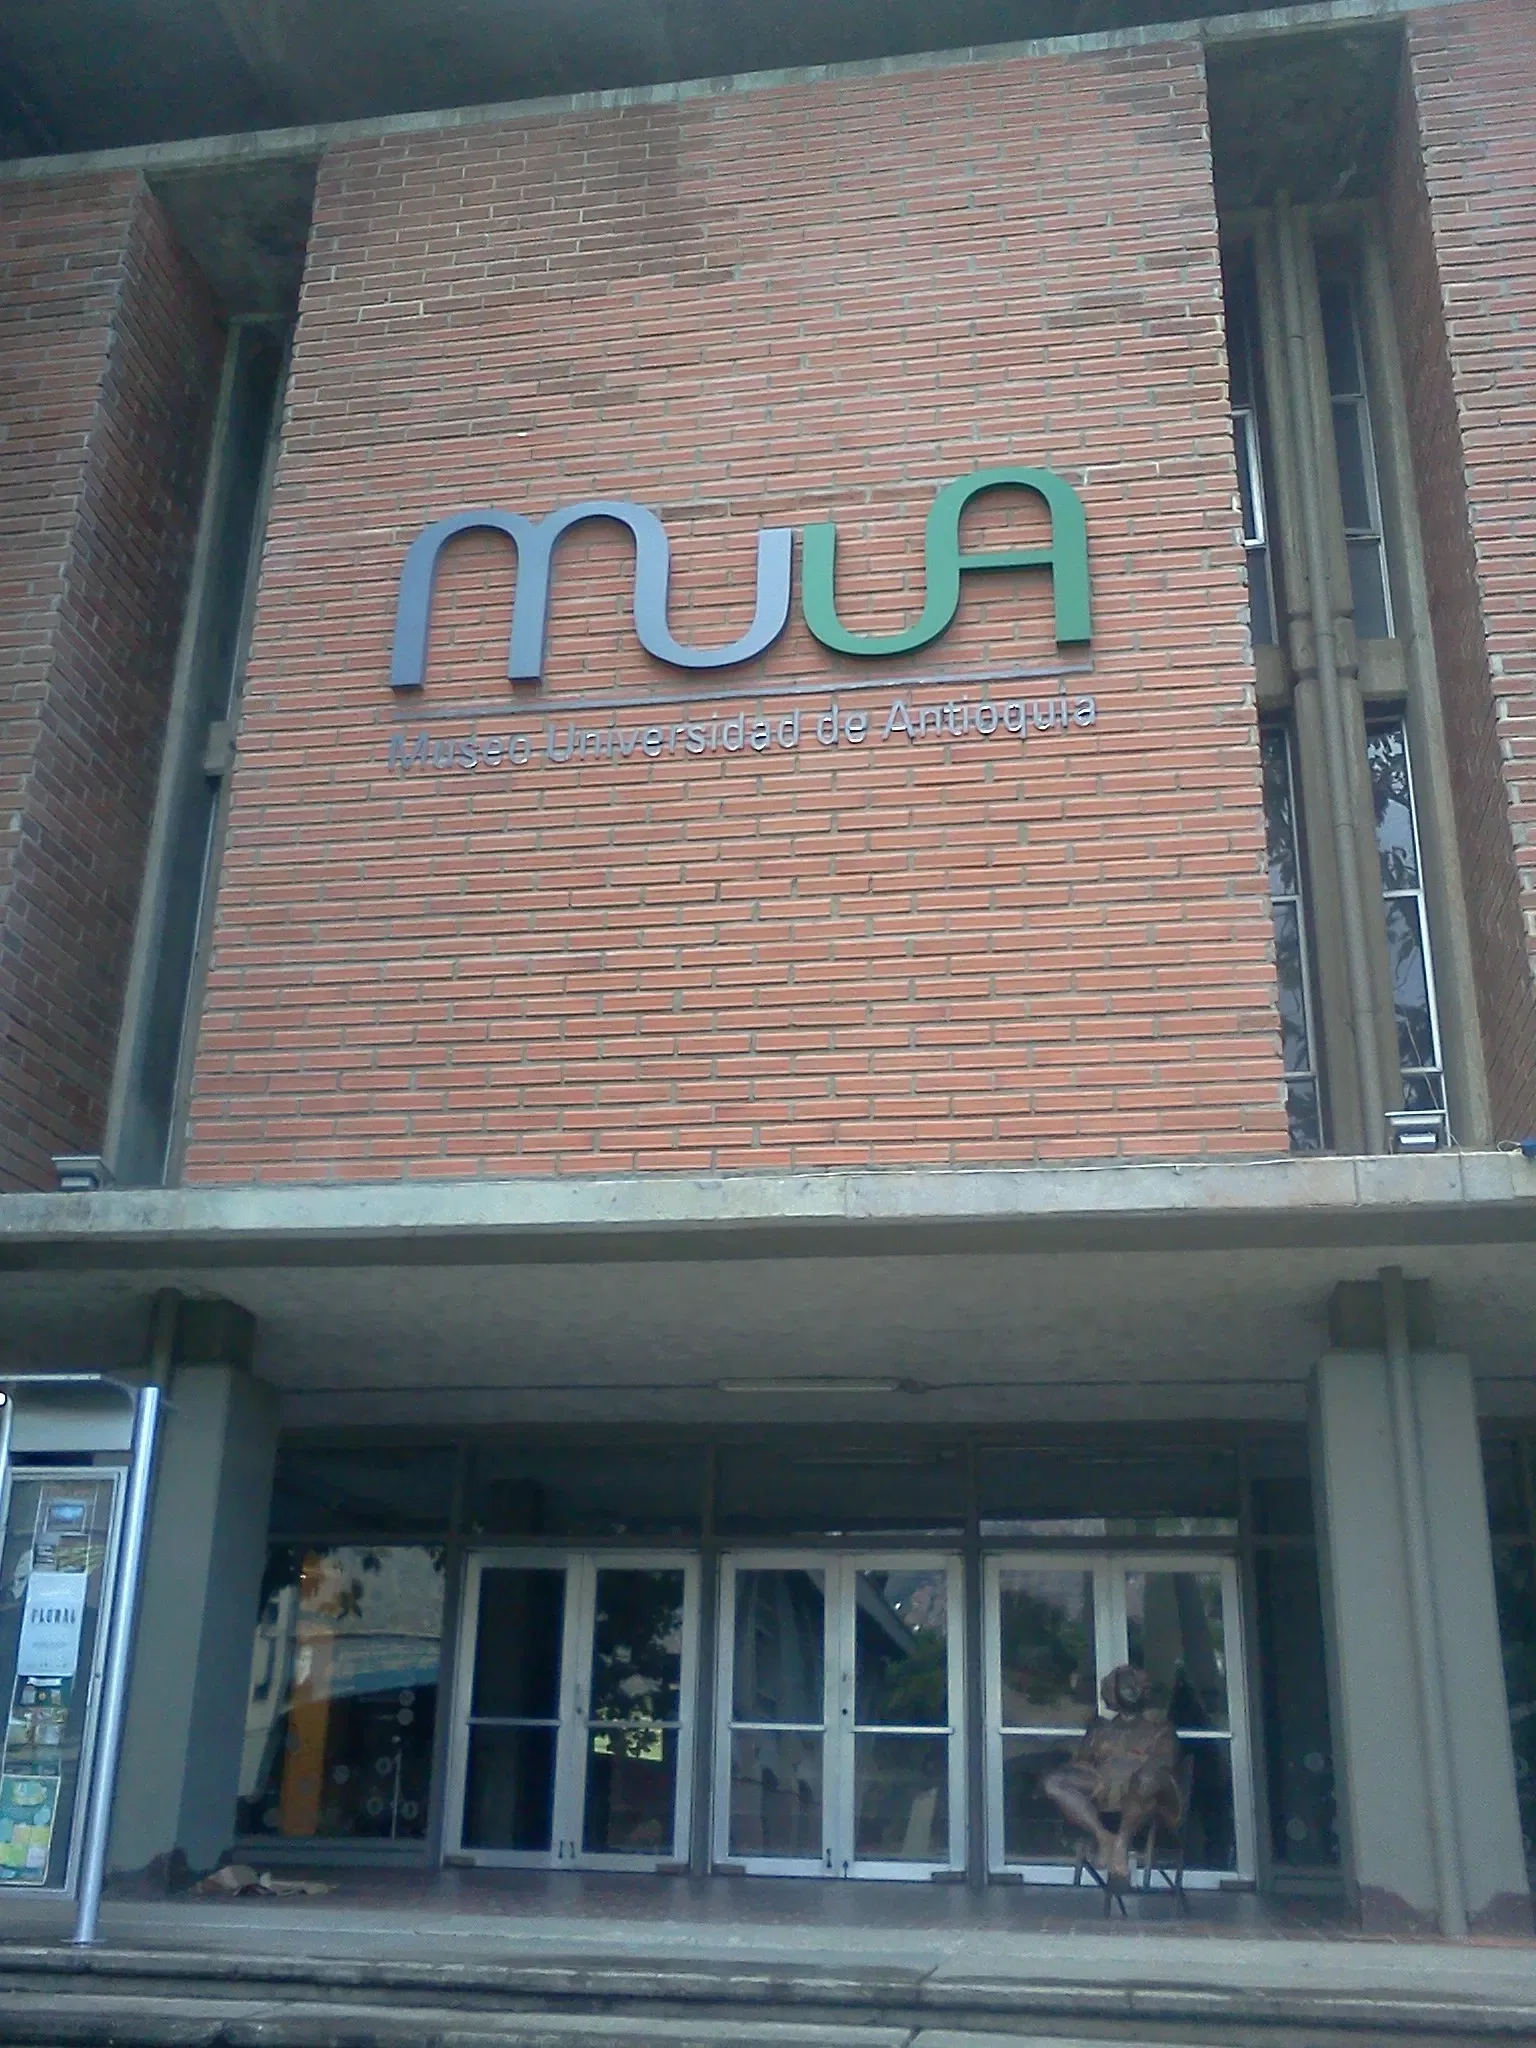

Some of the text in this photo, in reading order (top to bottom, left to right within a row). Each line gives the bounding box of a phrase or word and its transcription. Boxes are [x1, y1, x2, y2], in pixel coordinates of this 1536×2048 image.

[387, 690, 1097, 772] Museo Universidad de Antioquia
